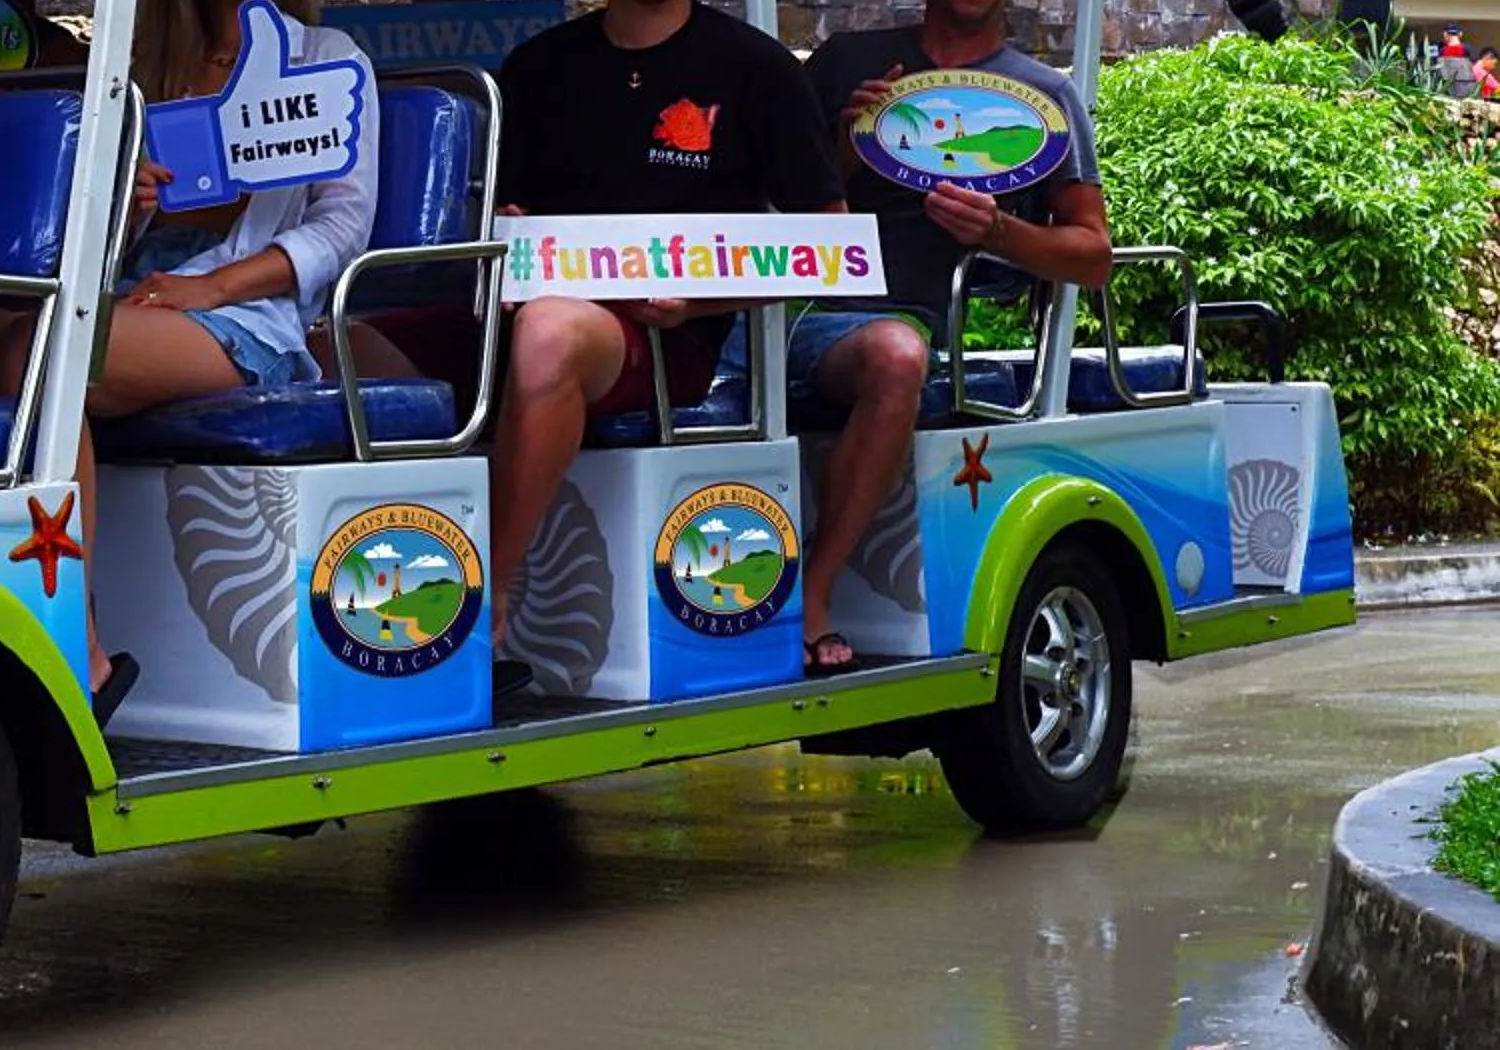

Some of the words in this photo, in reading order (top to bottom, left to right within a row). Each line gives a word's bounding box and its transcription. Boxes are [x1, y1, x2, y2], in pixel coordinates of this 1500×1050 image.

[350, 17, 548, 58] AIRWAYS
[261, 93, 320, 125] LIKE
[230, 128, 341, 165] Fairways!
[509, 234, 870, 286] #funatfairways
[323, 513, 384, 569] FAIRWAYS
[387, 512, 398, 524] &
[401, 510, 472, 561] BLUEWATER
[680, 597, 775, 634] BORACAY
[341, 633, 453, 672] BORACAY
